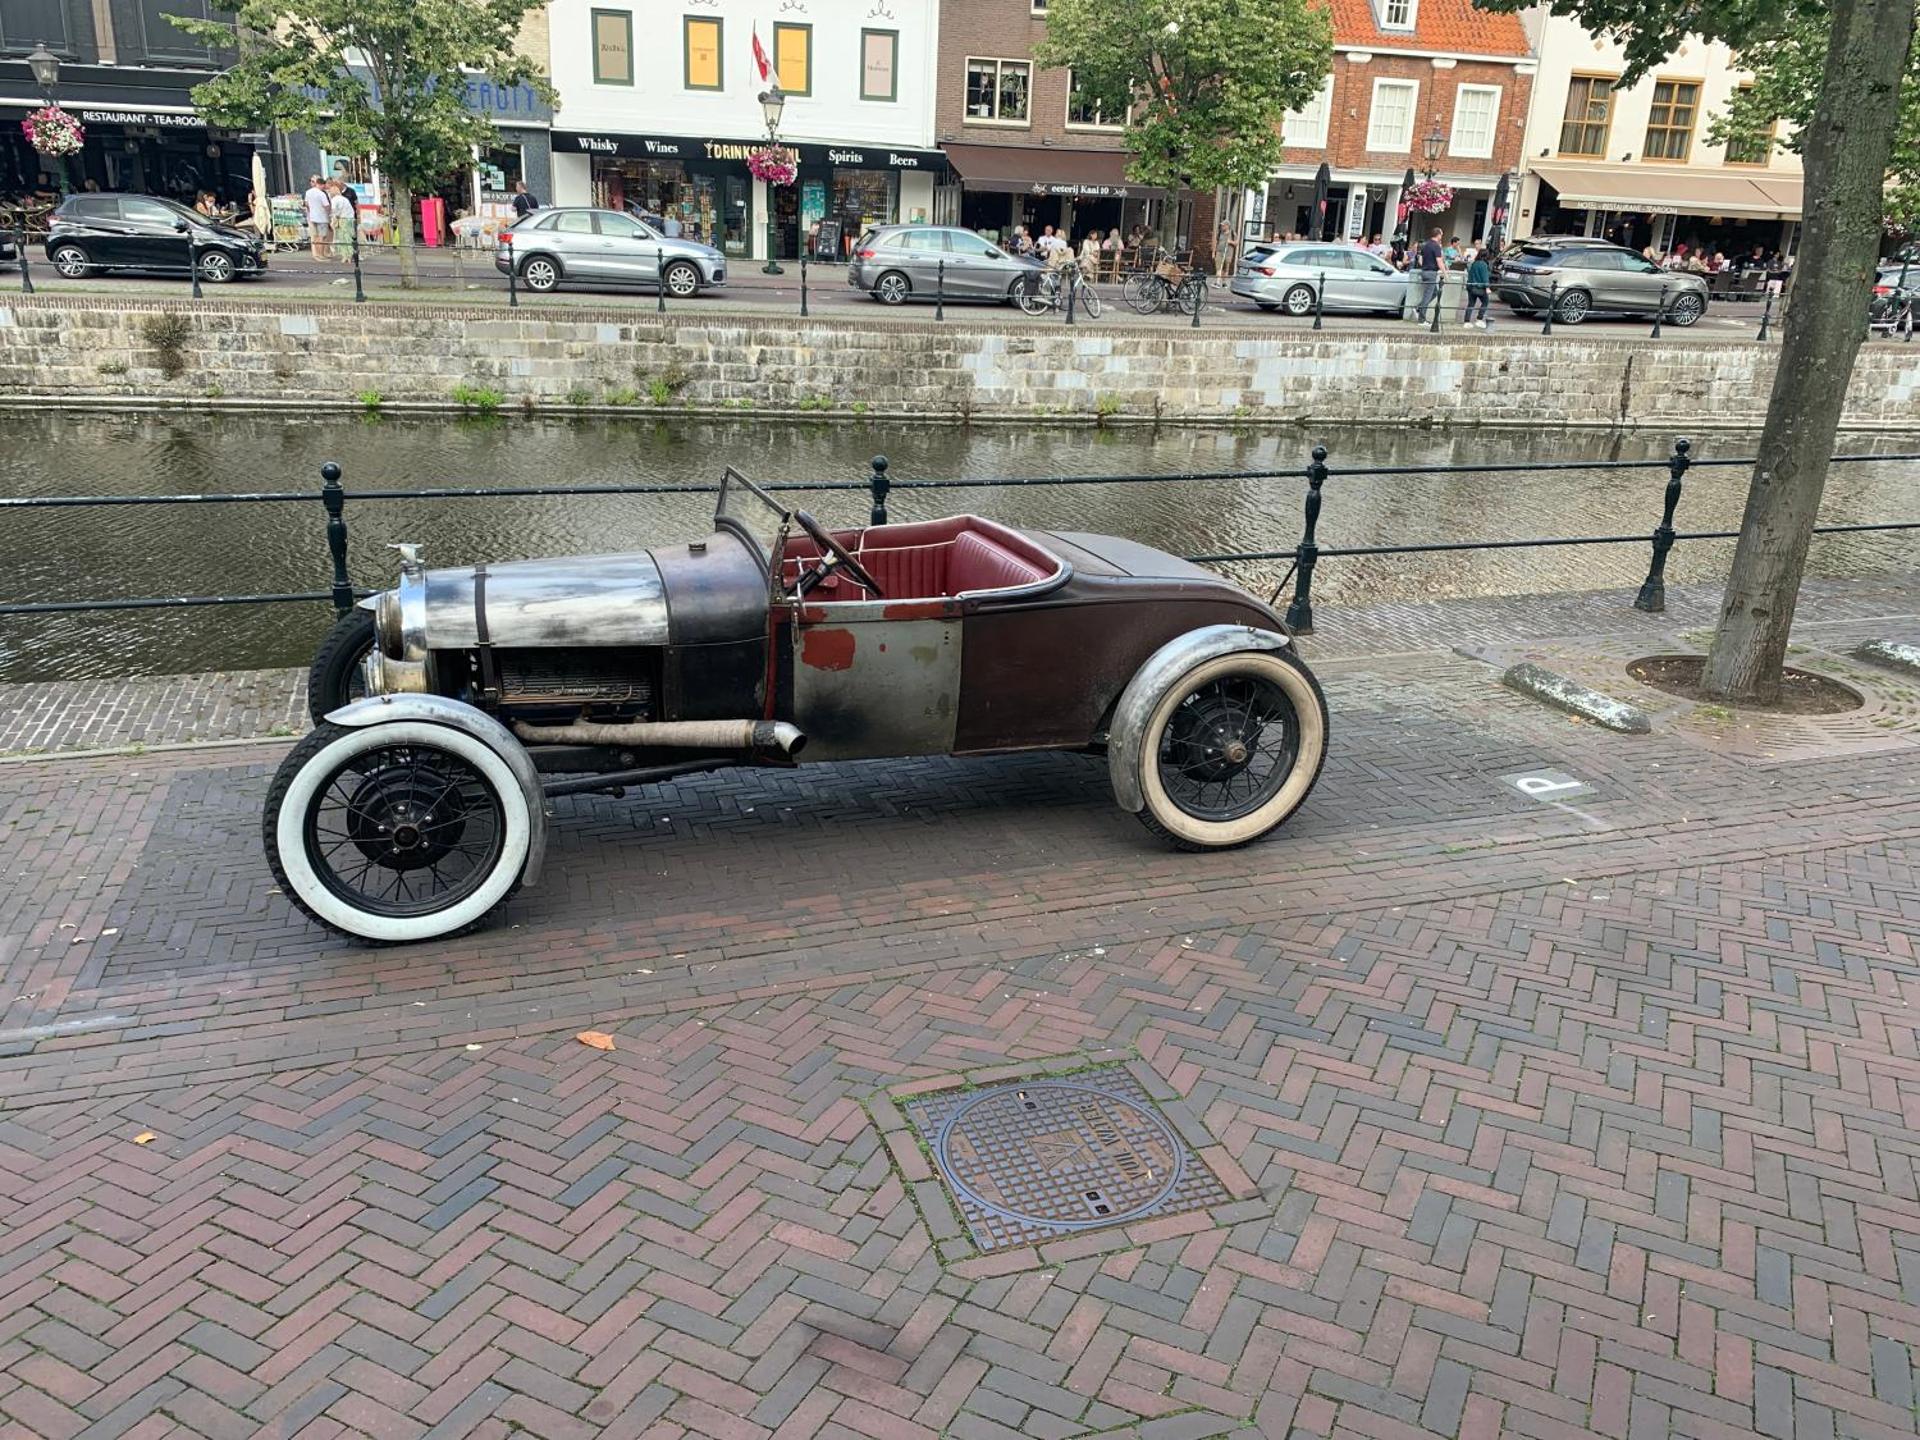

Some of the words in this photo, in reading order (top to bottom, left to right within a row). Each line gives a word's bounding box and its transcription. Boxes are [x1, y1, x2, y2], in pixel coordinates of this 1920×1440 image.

[458, 81, 535, 112] EAUTY
[82, 111, 146, 123] RESTAURANT
[153, 115, 207, 126] TEA-ROOM
[578, 137, 620, 154] Whisky
[644, 140, 679, 153] Wines
[828, 149, 864, 165] Spirits
[889, 153, 918, 166] Beers
[1051, 184, 1079, 196] eeterij
